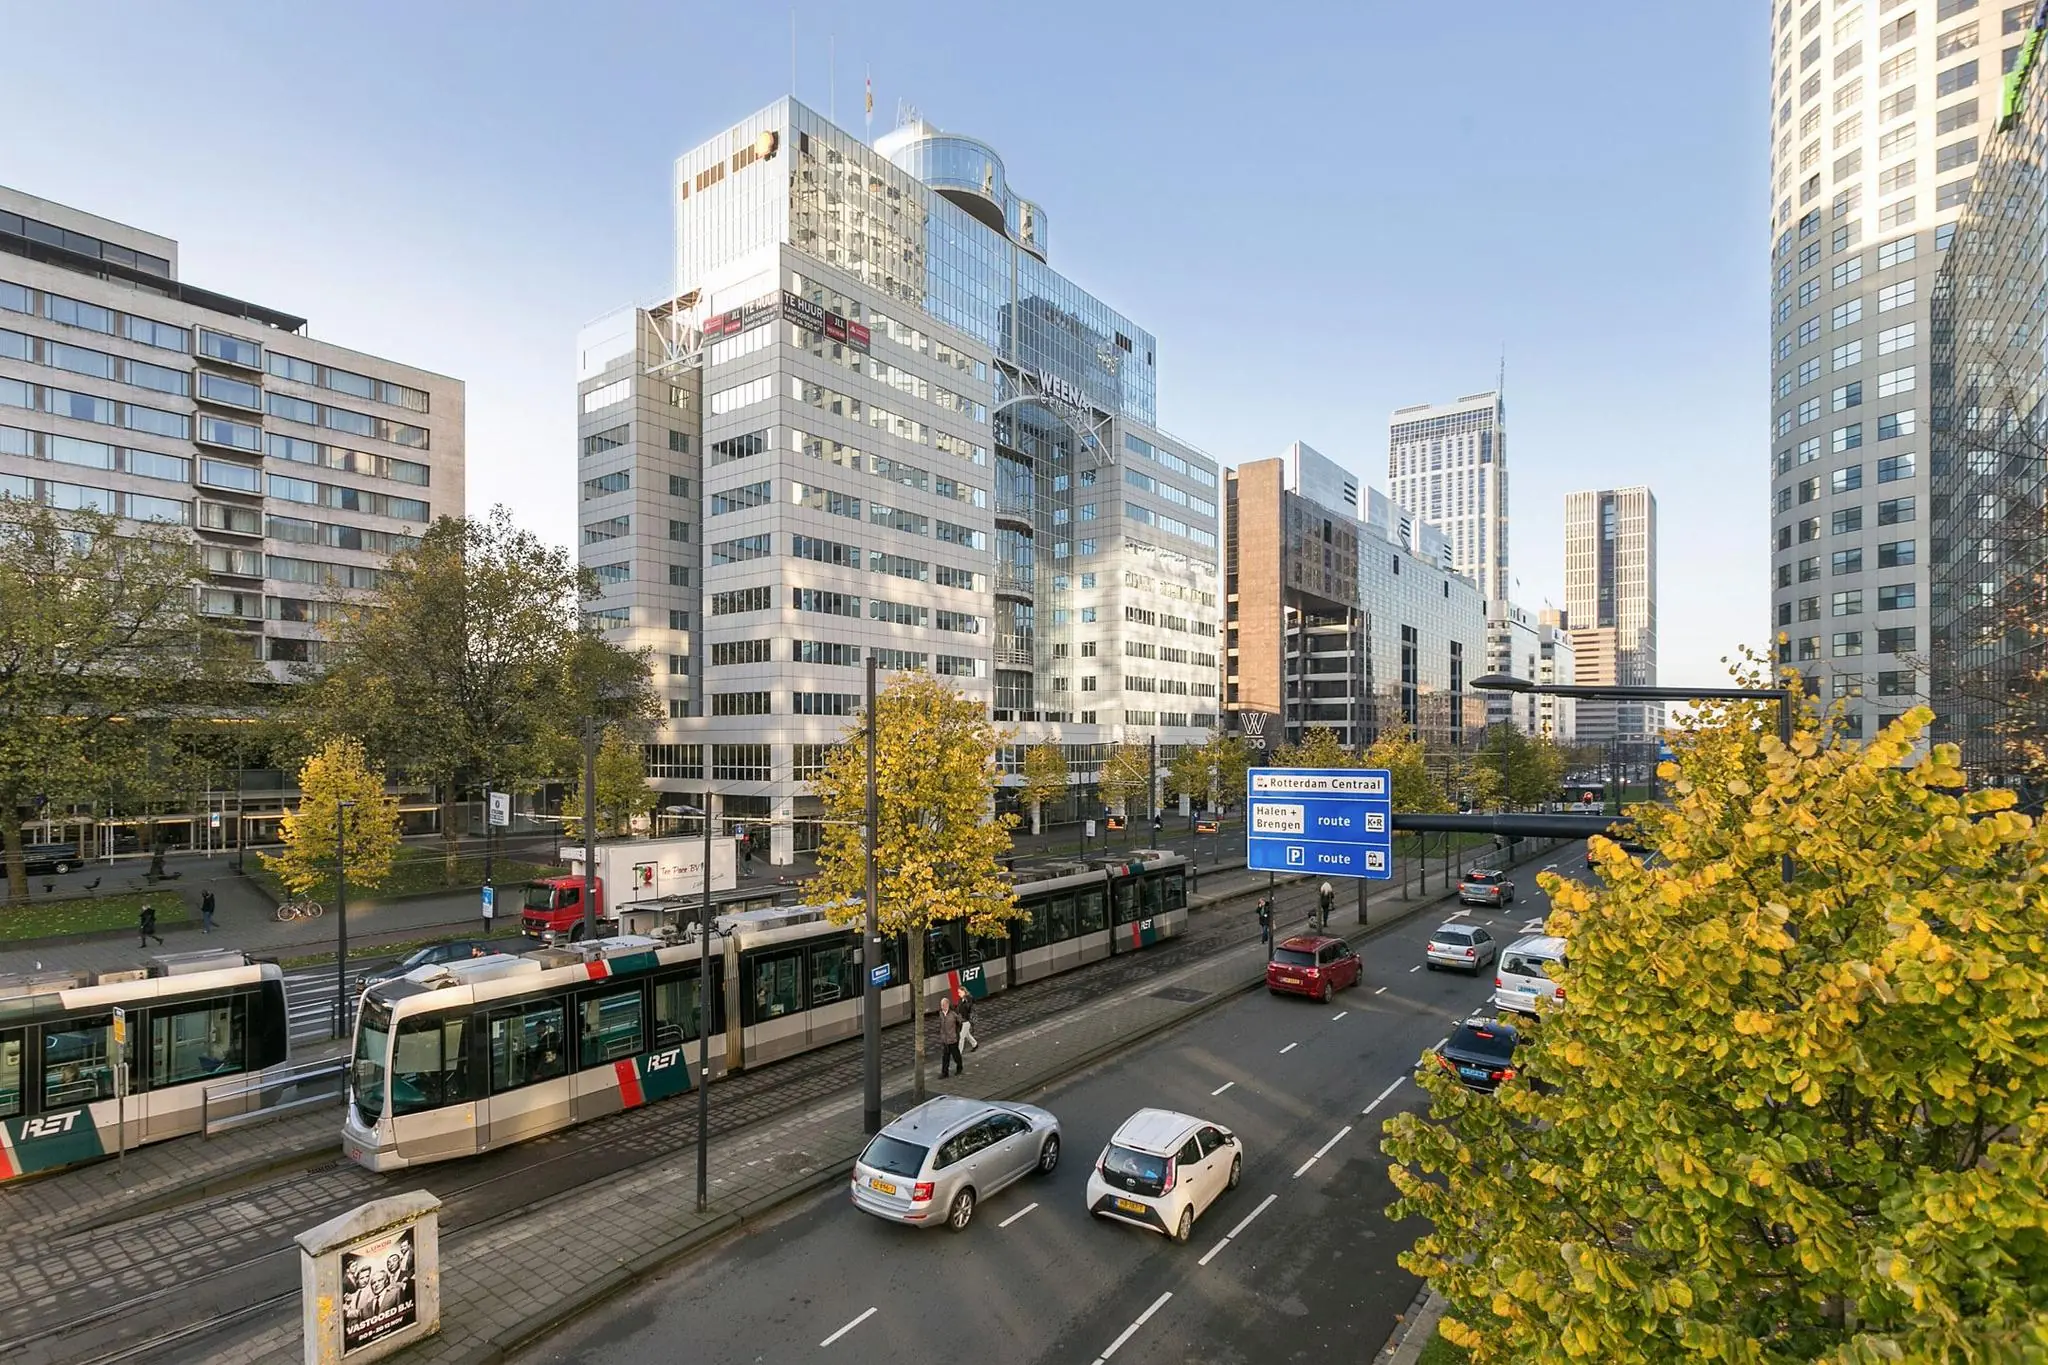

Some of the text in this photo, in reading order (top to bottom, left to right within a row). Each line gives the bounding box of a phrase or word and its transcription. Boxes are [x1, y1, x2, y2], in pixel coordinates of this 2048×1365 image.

[783, 292, 796, 307] TE
[798, 298, 823, 319] HUUR
[1037, 367, 1089, 412] WEENA
[1241, 713, 1267, 734] W
[1270, 778, 1381, 789] Rotterdam Centraal
[1256, 806, 1287, 816] Halen
[1256, 819, 1301, 831] Brengen
[1318, 816, 1351, 827] route
[1318, 854, 1351, 864] route
[1140, 919, 1152, 931] RET
[962, 966, 980, 982] RET
[647, 1048, 680, 1073] RET
[20, 1110, 82, 1141] RET
[346, 1307, 398, 1335] VASTGOED
[397, 1299, 414, 1313] B.V.
